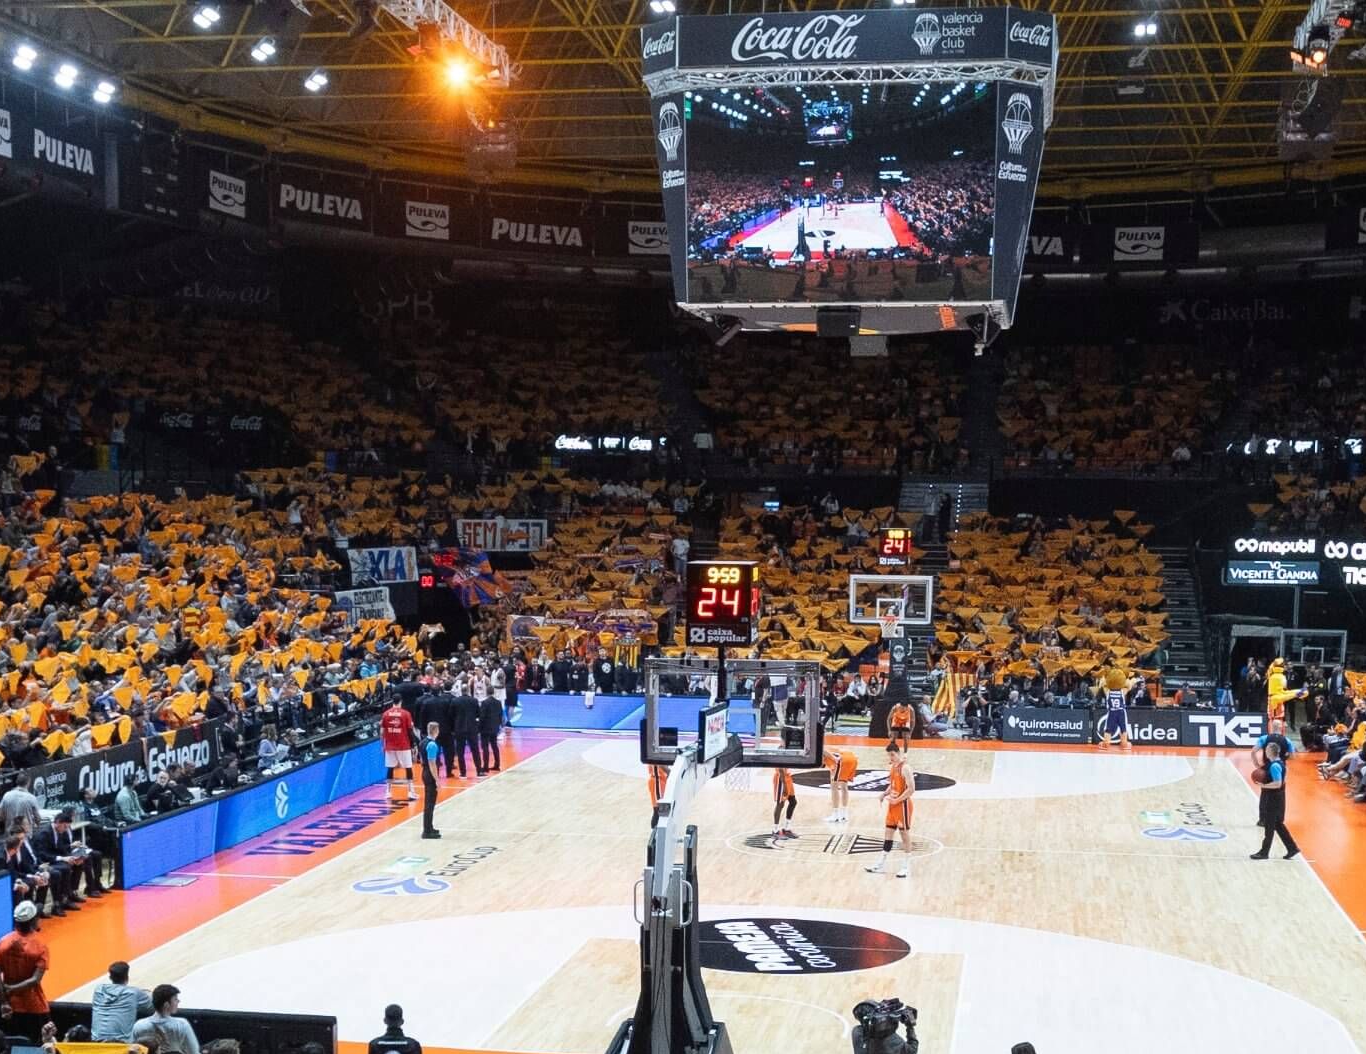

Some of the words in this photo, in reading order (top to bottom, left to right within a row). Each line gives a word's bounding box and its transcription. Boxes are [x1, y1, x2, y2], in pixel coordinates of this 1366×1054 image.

[942, 12, 983, 24] valencia
[731, 14, 866, 61] Coca-Cola
[941, 25, 975, 37] basket
[1009, 21, 1051, 46] Coca-Cola
[642, 31, 675, 58] Coca-Cola
[941, 37, 965, 49] club
[33, 128, 94, 175] PULEVA
[211, 175, 244, 196] PULEVA
[279, 184, 363, 220] PULEVA
[408, 205, 448, 220] PULEVA
[492, 217, 582, 247] PULEVA
[1118, 231, 1162, 243] PULEVA
[883, 539, 904, 554] 24
[707, 567, 741, 584] 9:59
[1229, 568, 1276, 580] VICENTE
[1278, 568, 1318, 581] GANDIA
[697, 587, 740, 617] 24
[707, 628, 734, 636] caixa
[707, 633, 747, 645] popular
[1189, 715, 1264, 746] TKE
[244, 798, 409, 856] VALENCIA
[424, 845, 499, 878] EuroCup
[714, 920, 804, 972] PAMESA
